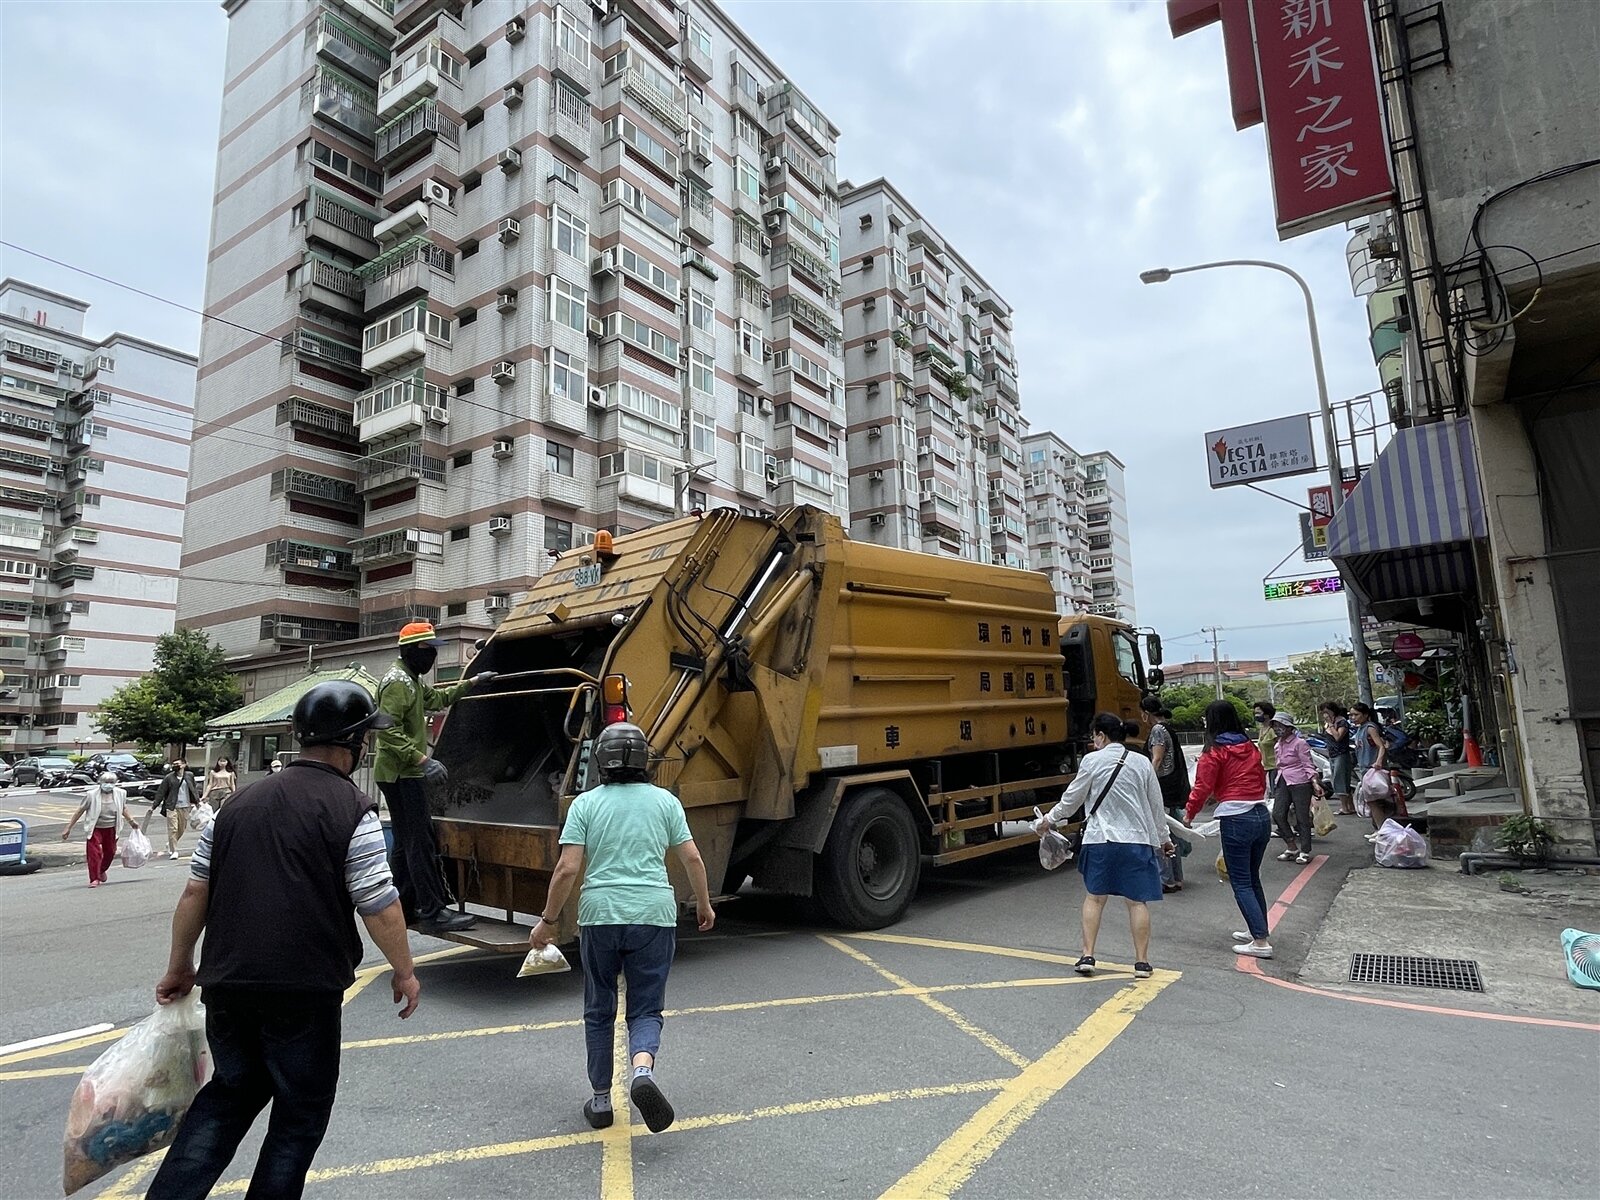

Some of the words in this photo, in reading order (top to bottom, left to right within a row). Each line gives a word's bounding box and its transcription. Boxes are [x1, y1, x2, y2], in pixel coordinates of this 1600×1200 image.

[1280, 0, 1358, 192] 新禾之家
[1213, 440, 1266, 464] VESTA
[1220, 458, 1268, 478] PASTA
